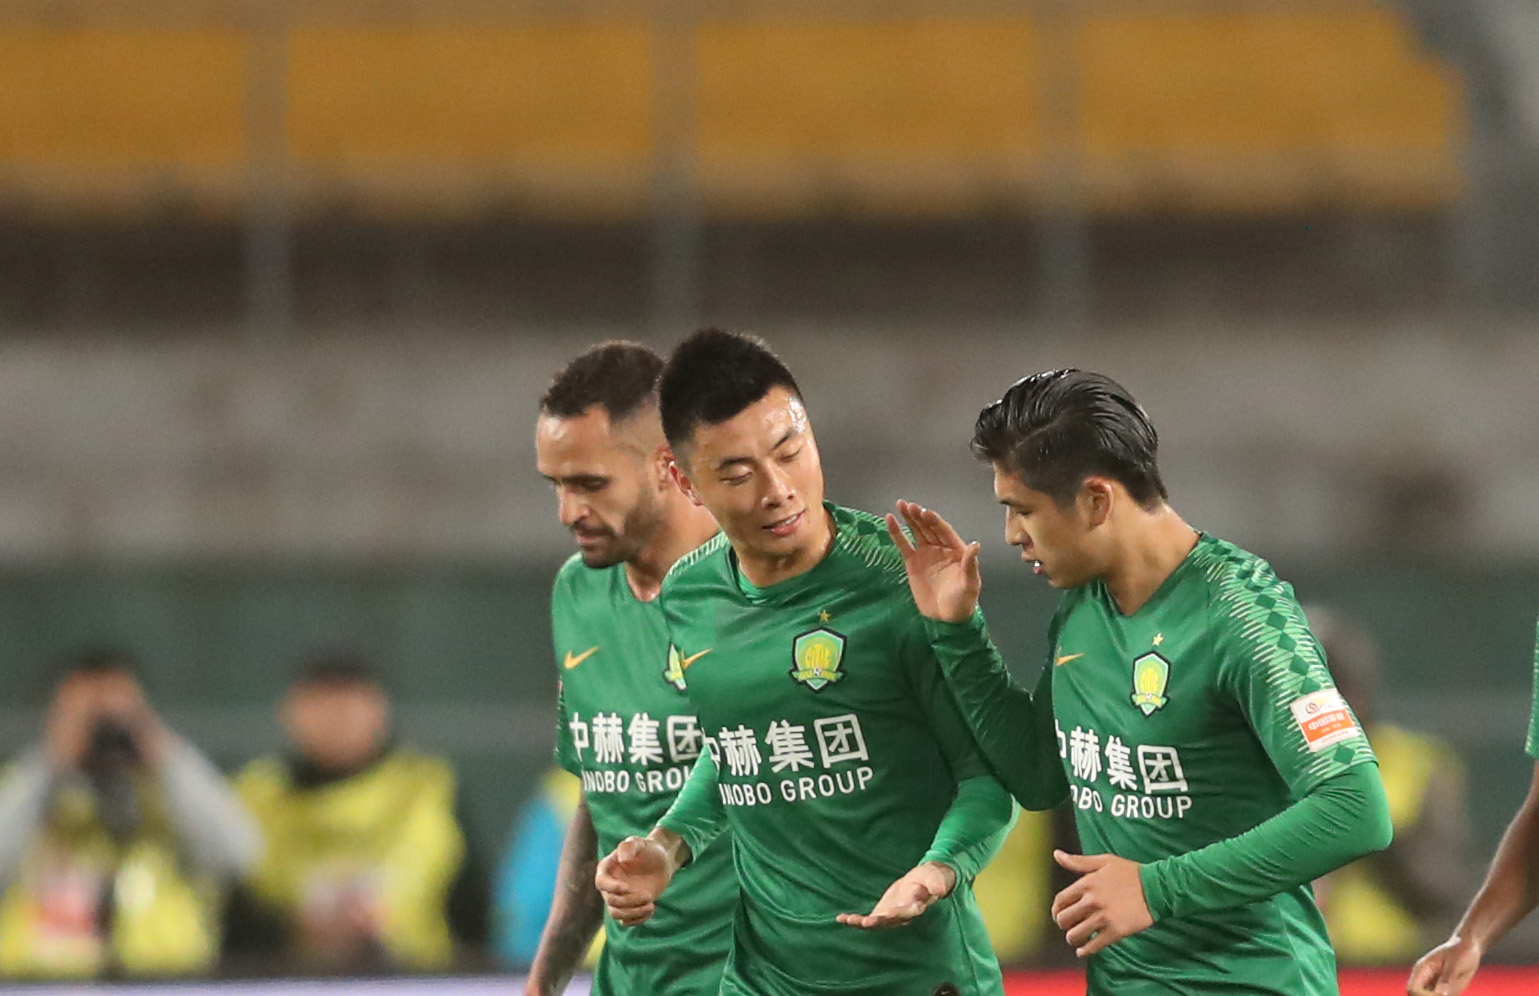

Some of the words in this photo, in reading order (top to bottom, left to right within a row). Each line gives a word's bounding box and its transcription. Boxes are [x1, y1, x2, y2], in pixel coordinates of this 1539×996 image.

[583, 770, 630, 793] INOBO
[718, 782, 772, 806] INOBO
[781, 767, 874, 801] GROUP
[1111, 794, 1192, 819] GROUP
